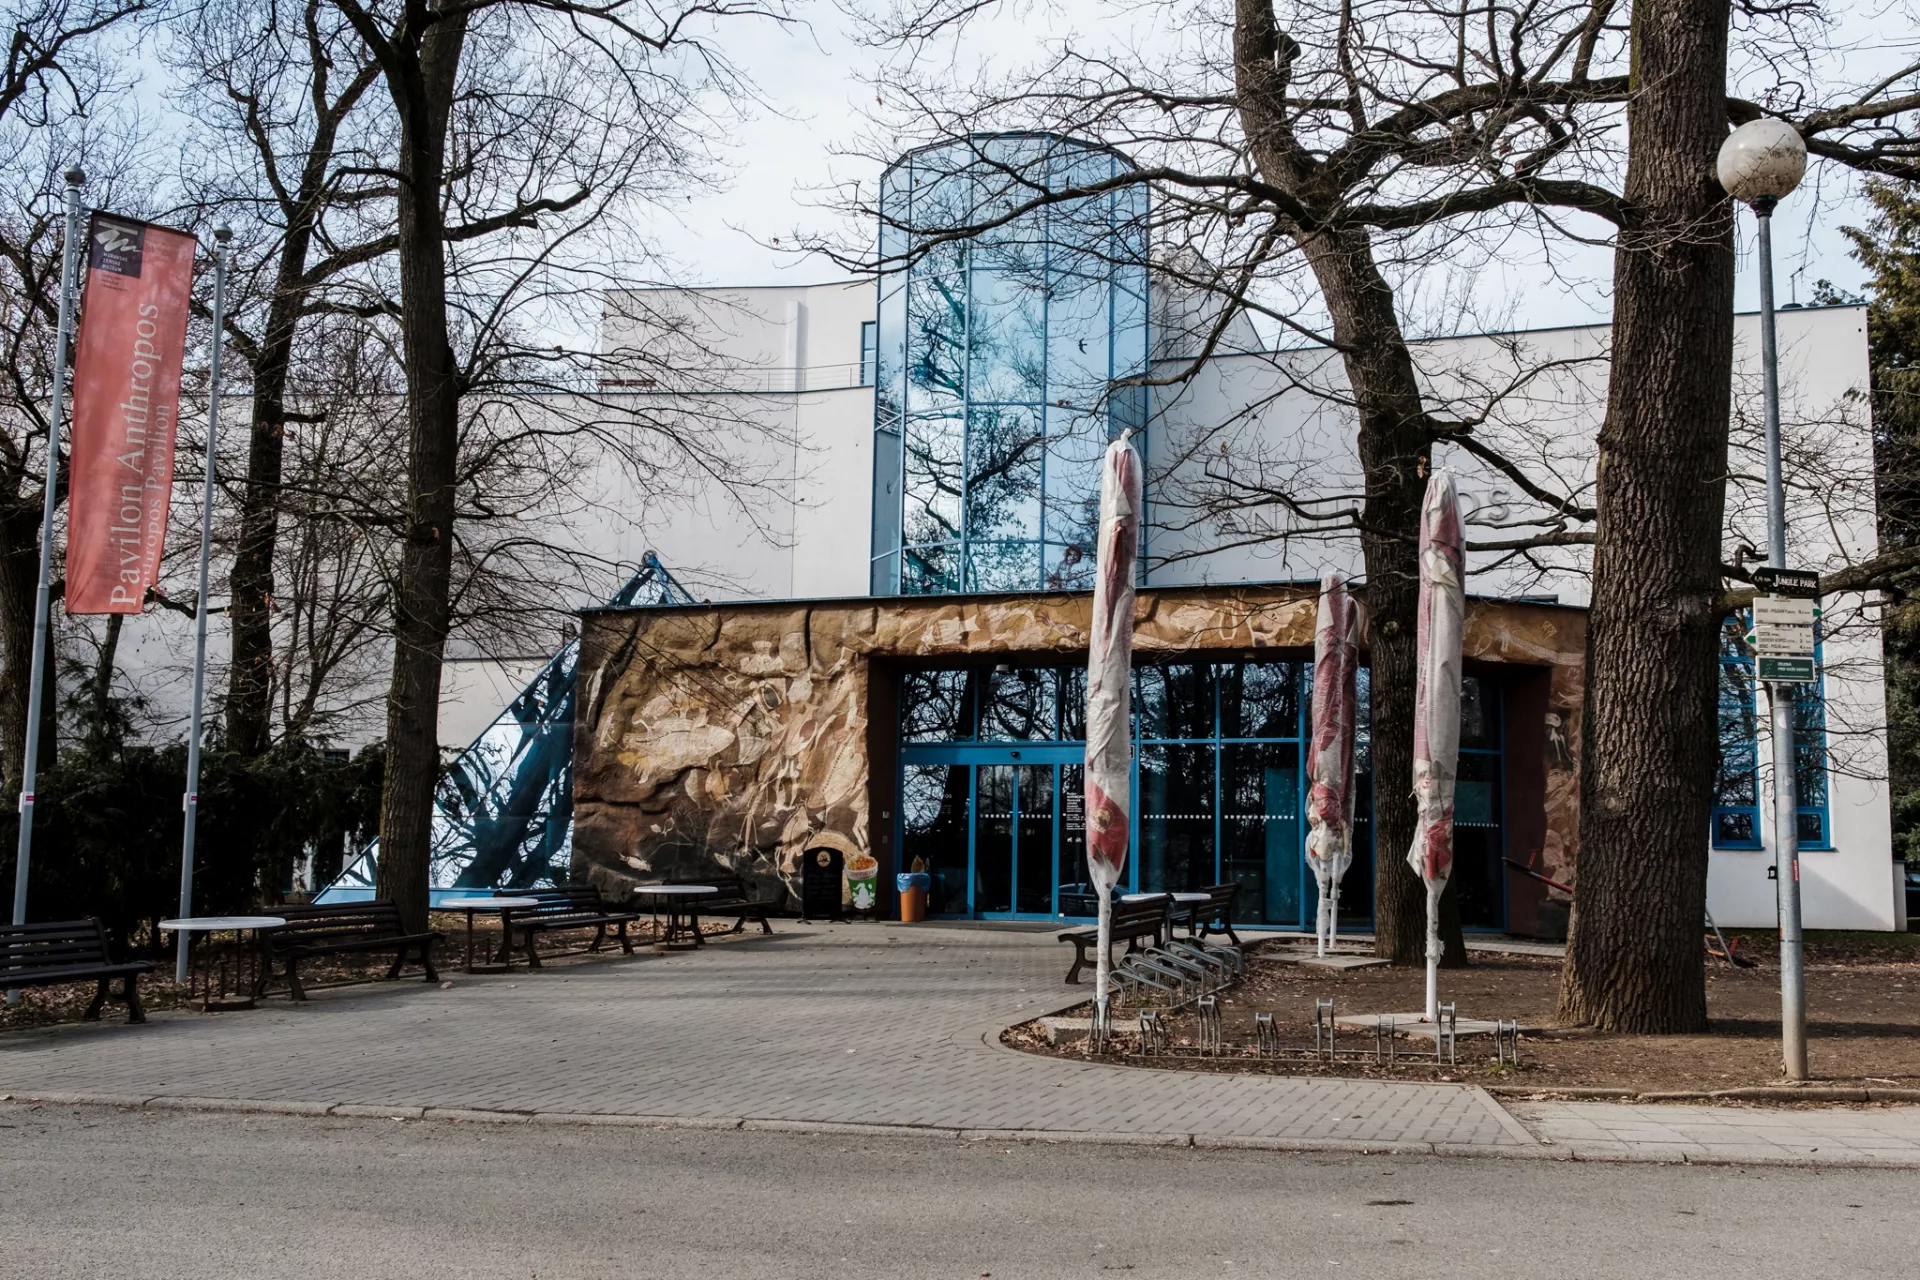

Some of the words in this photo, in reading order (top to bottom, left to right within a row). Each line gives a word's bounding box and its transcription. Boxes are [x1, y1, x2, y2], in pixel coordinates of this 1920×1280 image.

[117, 303, 162, 476] Anthropos
[145, 404, 170, 491] Pavilion
[110, 484, 142, 606] Pavilon
[140, 499, 162, 600] nthropos
[1773, 574, 1799, 587] JUNGLE
[1800, 579, 1817, 588] PARK
